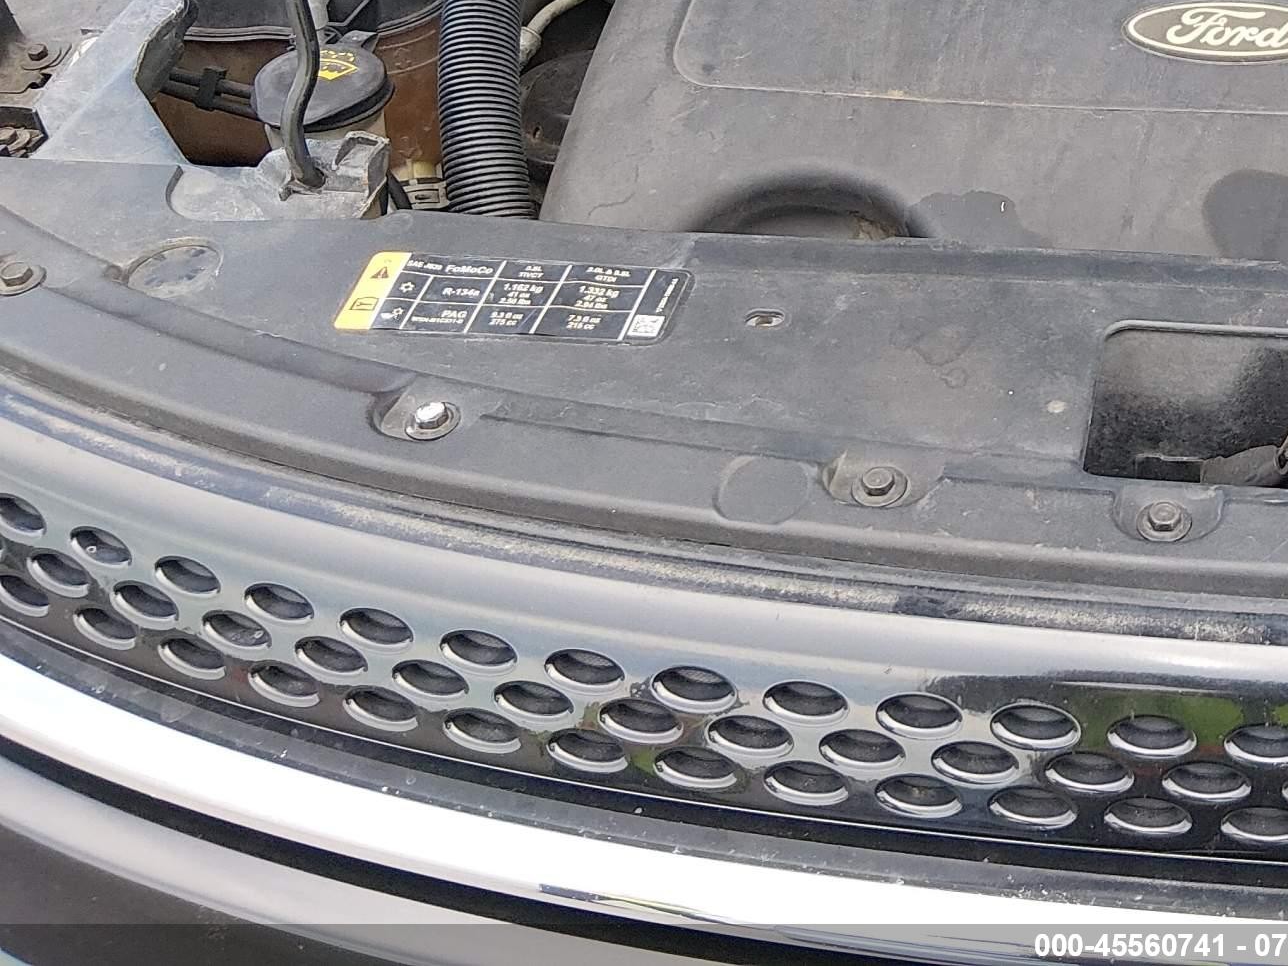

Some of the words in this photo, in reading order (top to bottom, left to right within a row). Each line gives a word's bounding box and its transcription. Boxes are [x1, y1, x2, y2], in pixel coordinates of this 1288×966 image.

[445, 265, 494, 274] FoMoCo
[442, 287, 480, 296] R-134a
[529, 285, 544, 294] kg
[605, 289, 620, 299] kg
[441, 310, 468, 318] PAG
